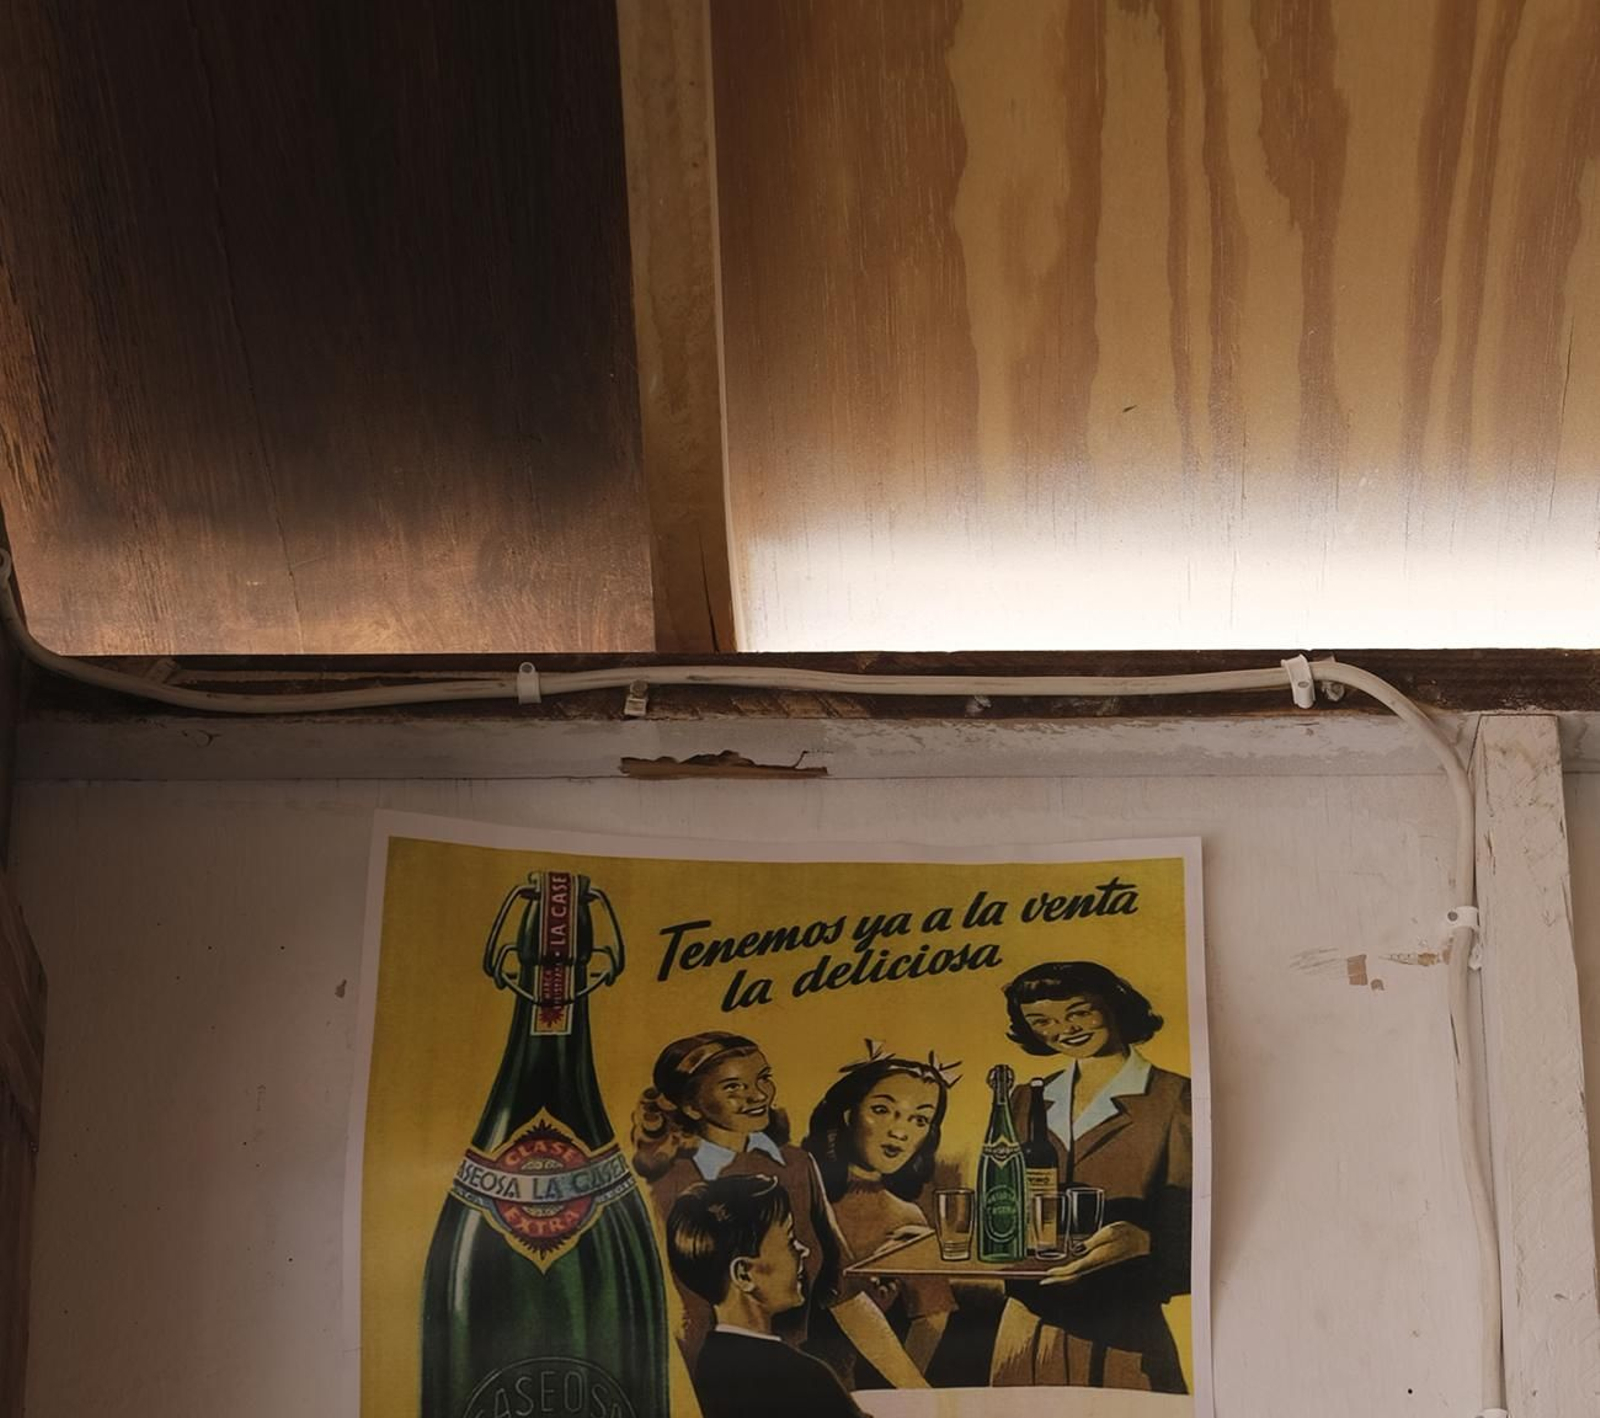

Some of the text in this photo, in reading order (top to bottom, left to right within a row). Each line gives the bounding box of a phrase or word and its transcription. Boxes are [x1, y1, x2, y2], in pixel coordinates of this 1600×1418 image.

[551, 924, 567, 945] LA
[657, 876, 1140, 982] Tenemos ya a la venta
[720, 942, 1004, 1013] la deliciosa
[504, 1140, 577, 1166] CLASE
[533, 1177, 563, 1200] LA
[504, 1206, 581, 1233] EXTRA
